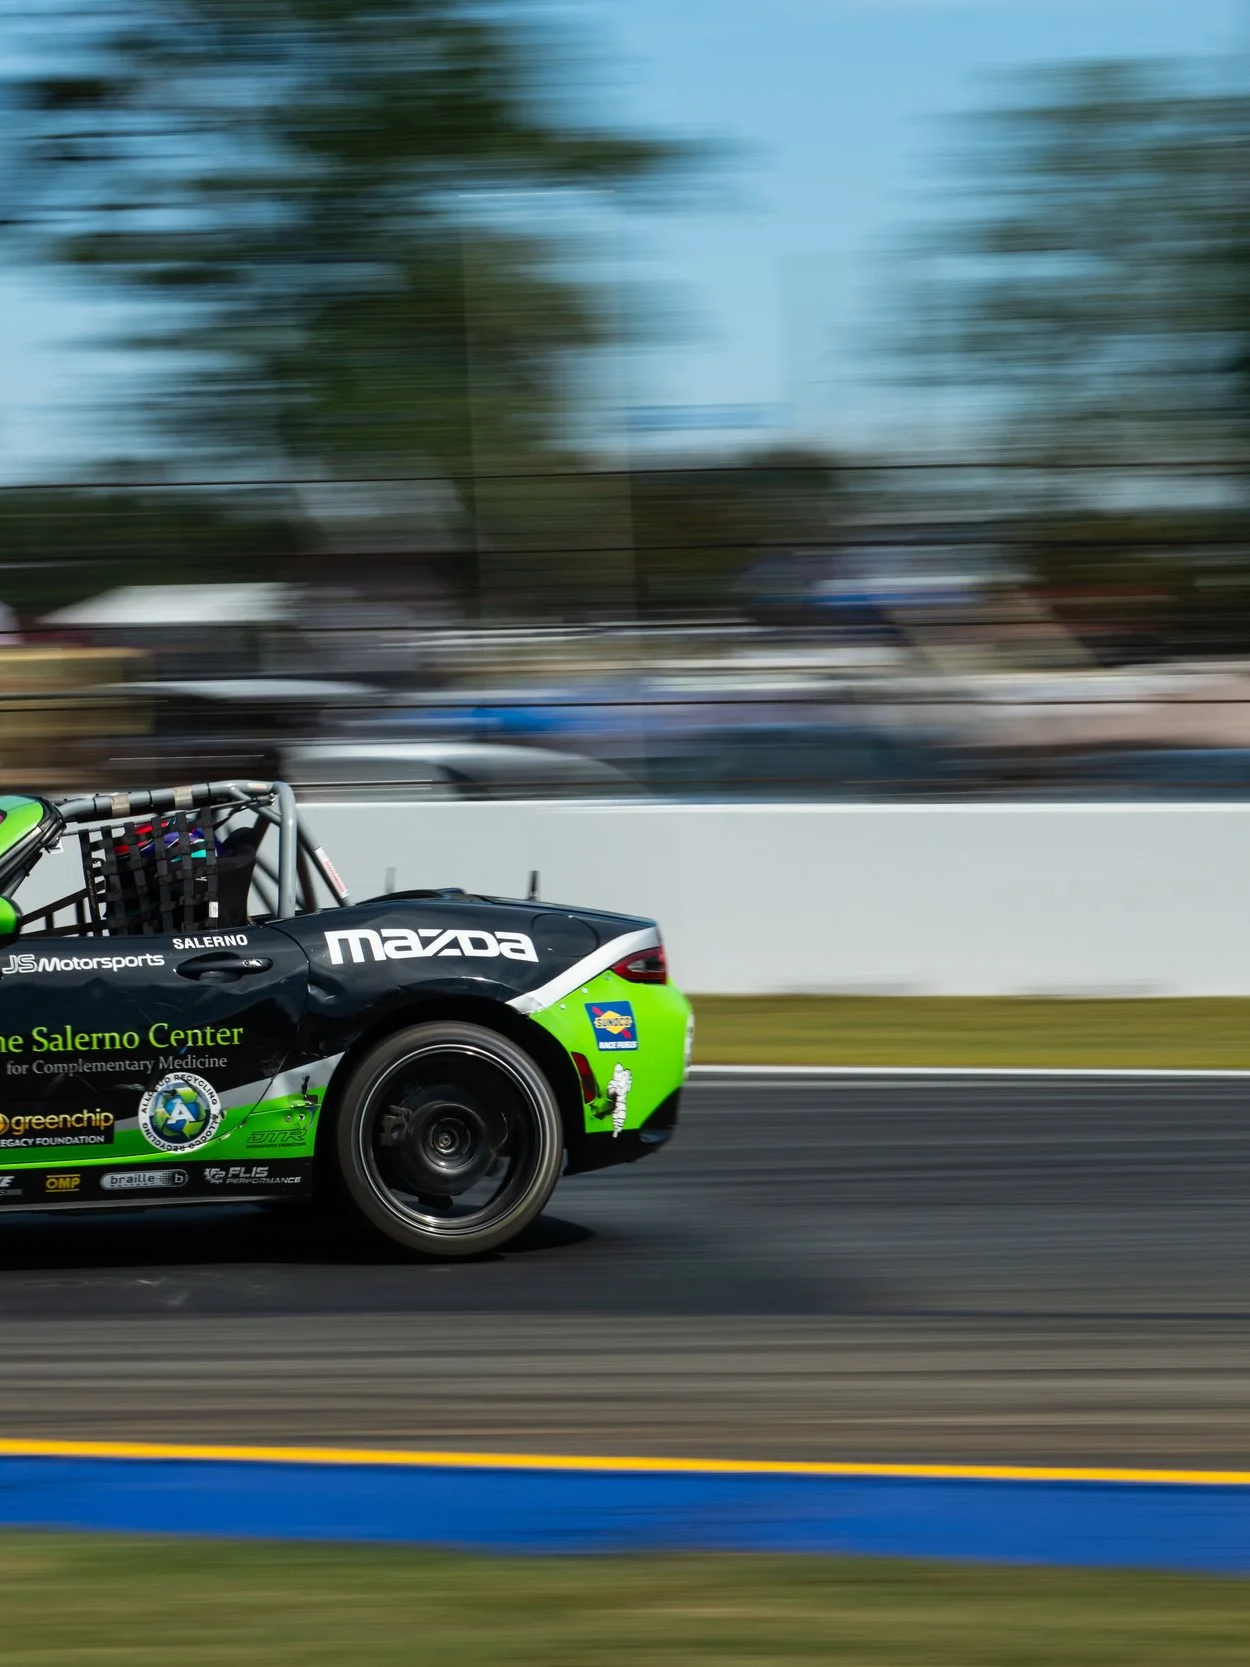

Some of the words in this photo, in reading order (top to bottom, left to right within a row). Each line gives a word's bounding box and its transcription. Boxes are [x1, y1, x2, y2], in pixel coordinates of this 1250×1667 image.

[172, 934, 248, 950] SALERNO
[31, 1025, 140, 1052] Salerno
[148, 1022, 244, 1048] Center
[6, 1060, 29, 1075] for
[32, 1057, 155, 1077] Complementary
[158, 1054, 228, 1070] Medicine
[173, 1074, 218, 1106] RECYCLING
[166, 1098, 197, 1125] A
[11, 1108, 114, 1135] greenchip
[35, 1135, 105, 1145] FOUNDATION
[174, 1173, 183, 1183] b
[228, 1166, 269, 1177] FLIS
[45, 1177, 81, 1189] OMP
[110, 1174, 155, 1184] braille
[226, 1176, 301, 1185] PERFORMANCE
